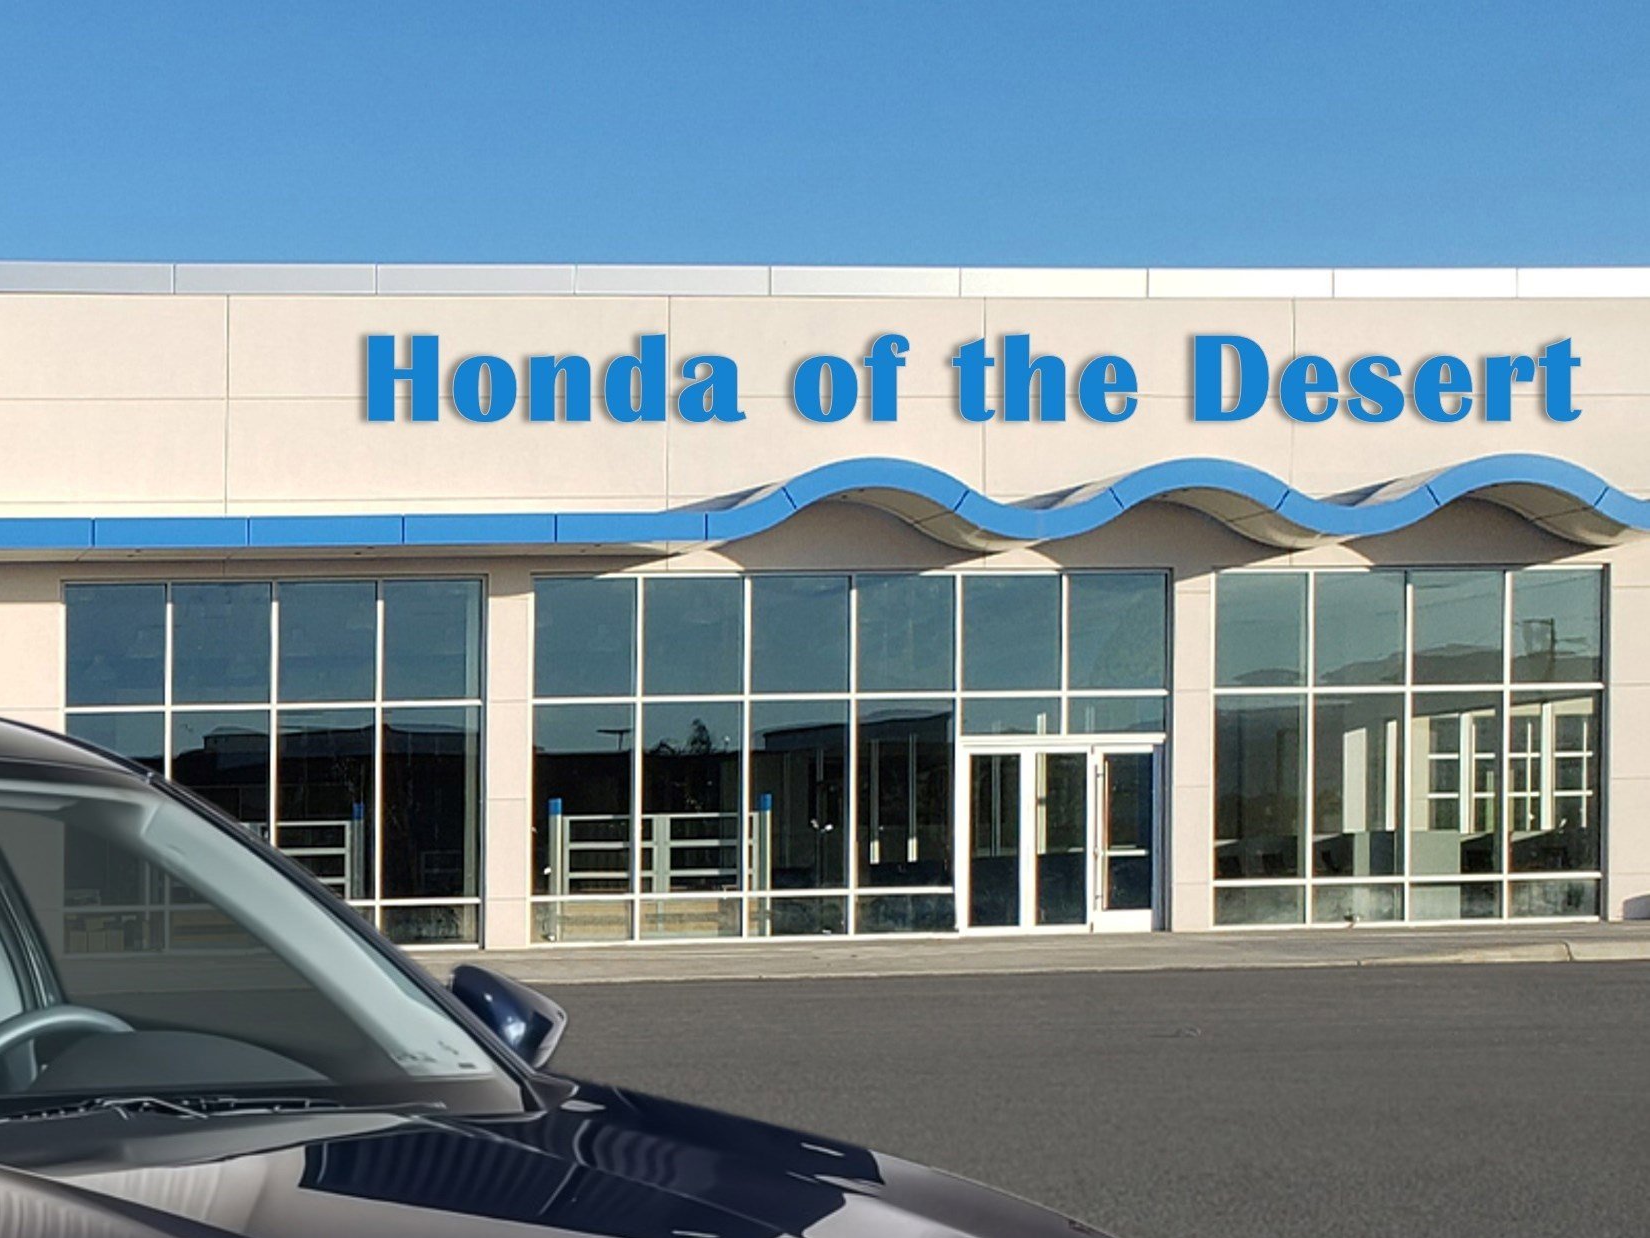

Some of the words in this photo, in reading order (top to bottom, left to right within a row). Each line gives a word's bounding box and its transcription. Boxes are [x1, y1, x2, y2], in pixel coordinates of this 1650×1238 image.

[364, 333, 748, 424] Honda
[792, 332, 911, 424] of
[951, 333, 1139, 424] the
[1192, 334, 1583, 424] Desert
